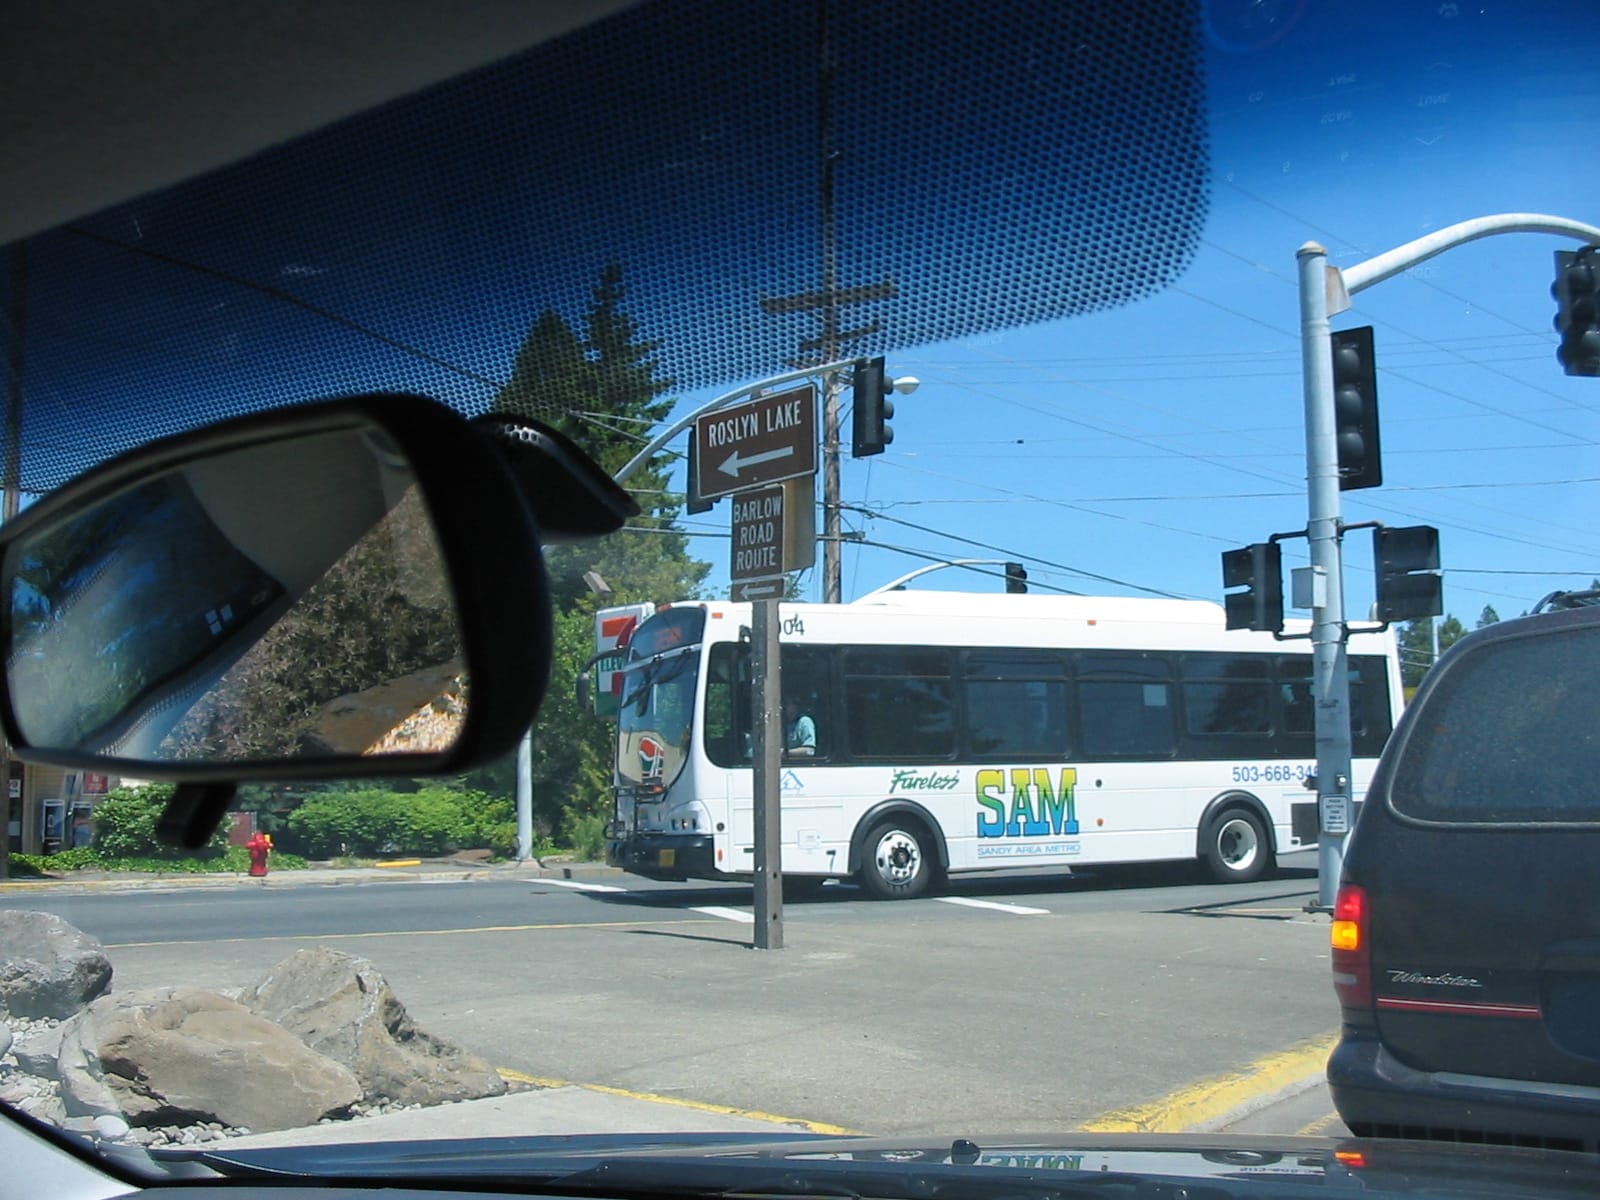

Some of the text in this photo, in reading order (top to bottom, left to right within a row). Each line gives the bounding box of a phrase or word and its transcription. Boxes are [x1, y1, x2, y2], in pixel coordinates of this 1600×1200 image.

[708, 400, 802, 448] ROSLYN LAKE
[734, 496, 783, 524] BARLOW
[740, 522, 774, 546] ROAD
[736, 546, 777, 571] ROUTE
[779, 613, 805, 636] 04
[889, 769, 960, 794] Fareless
[976, 767, 1080, 838] SAM
[977, 844, 1080, 856] SANDY AREA METRO
